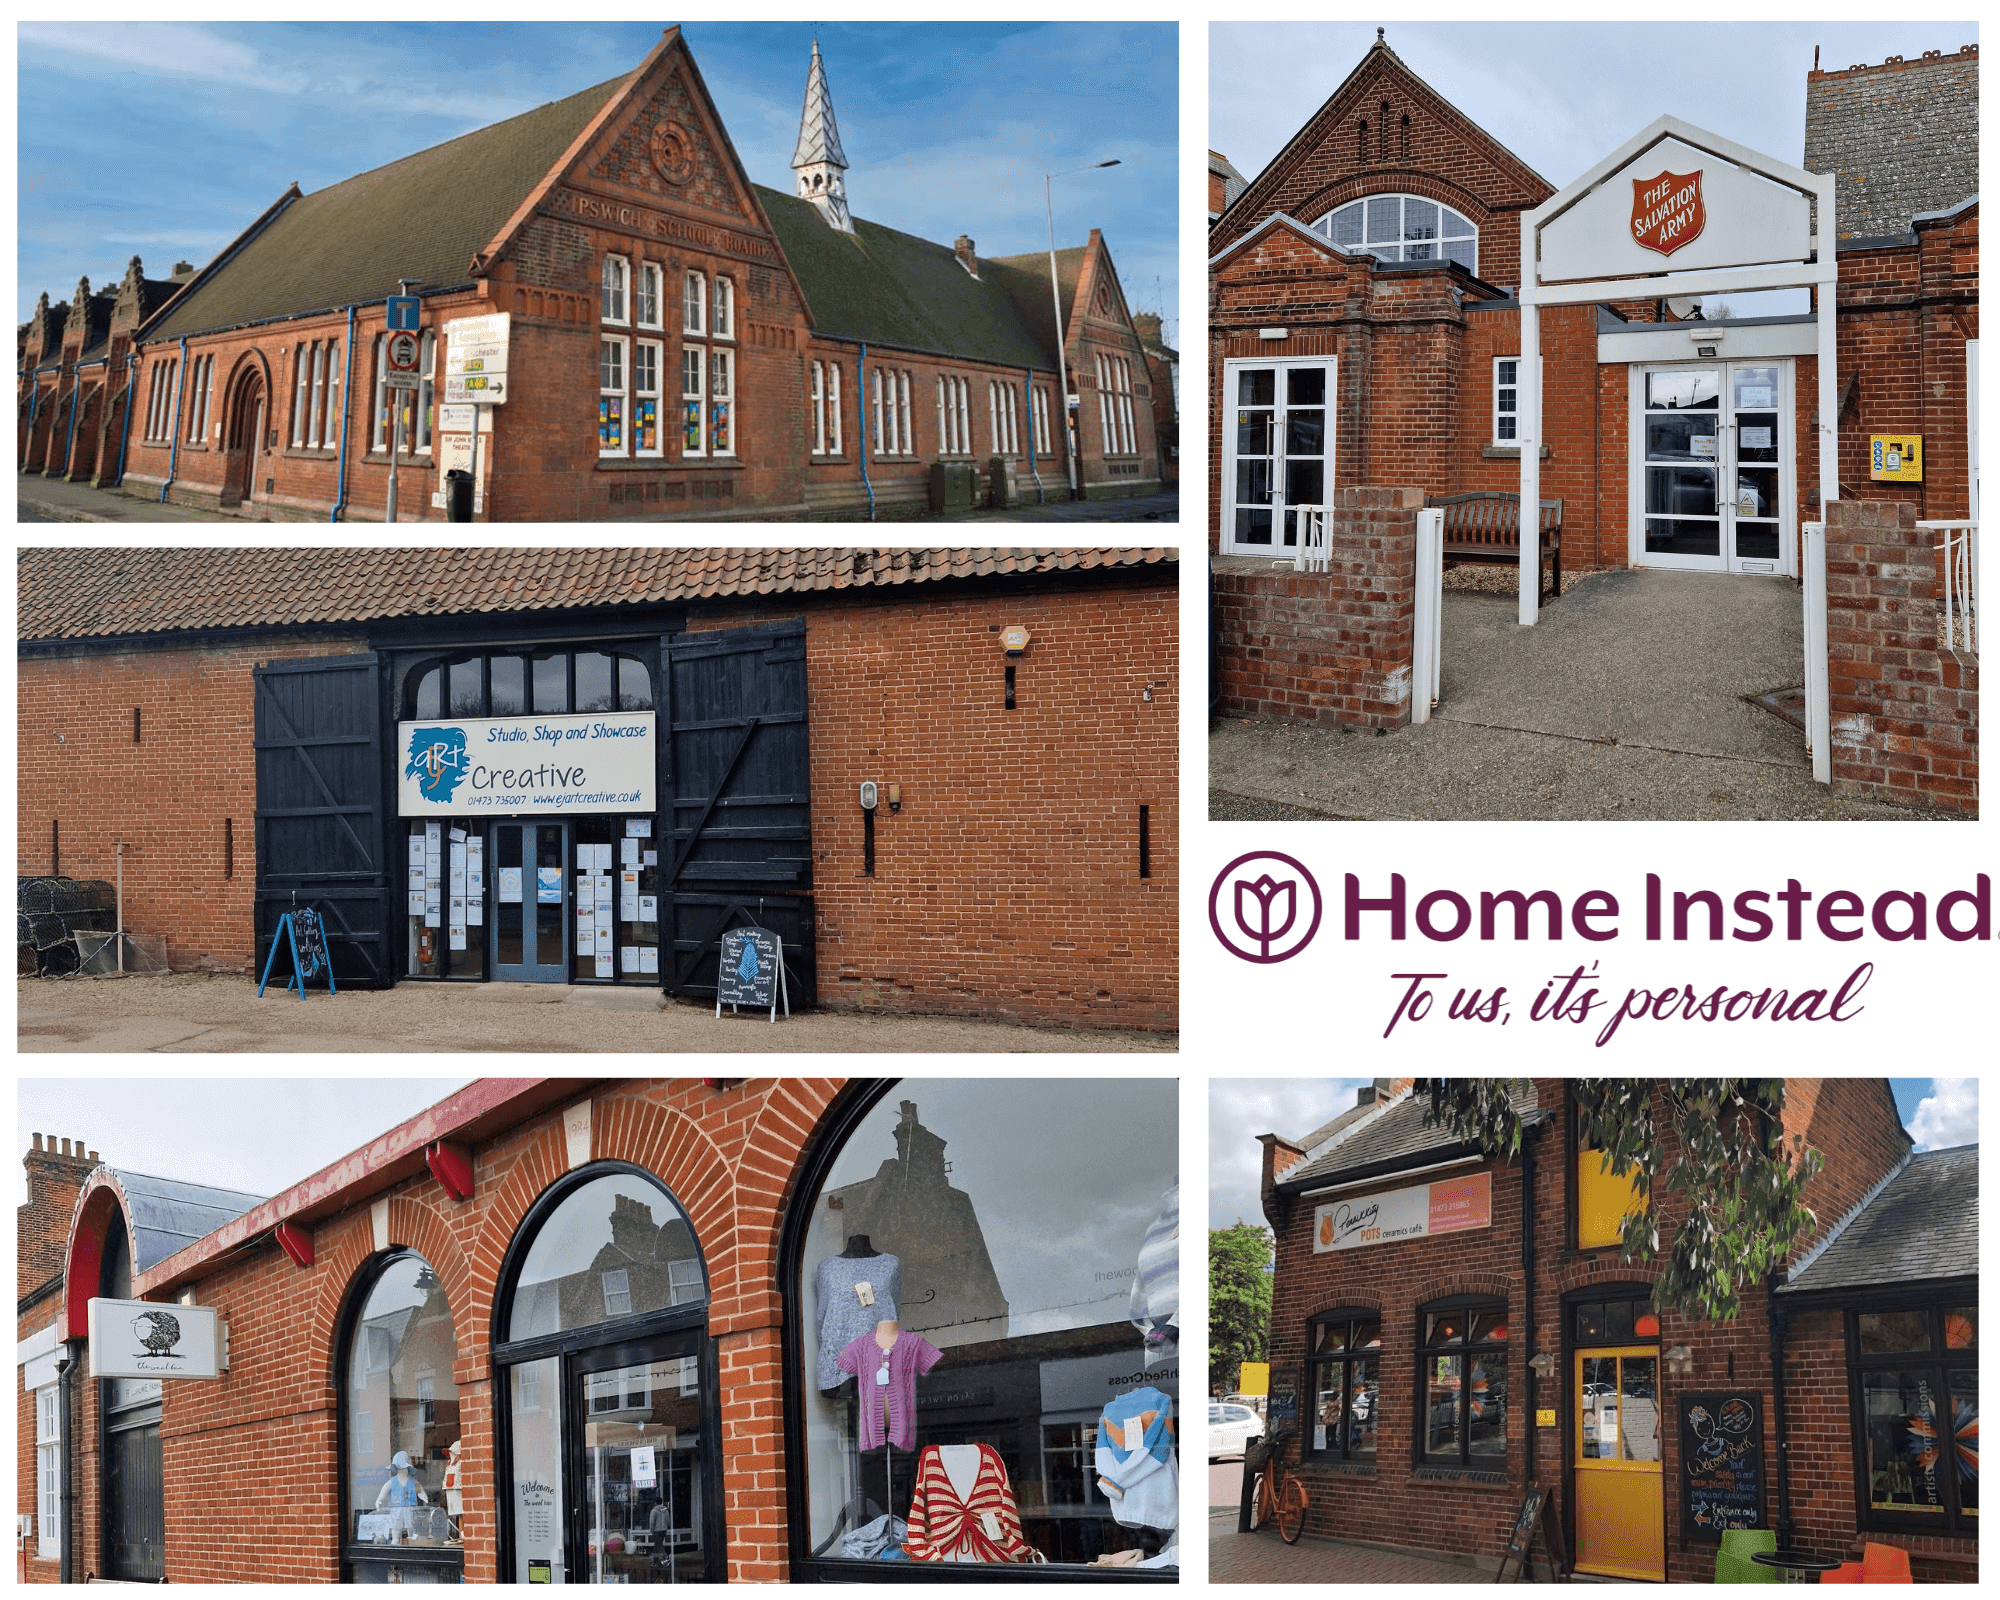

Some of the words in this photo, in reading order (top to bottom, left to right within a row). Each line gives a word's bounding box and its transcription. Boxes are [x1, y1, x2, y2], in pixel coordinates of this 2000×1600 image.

[1643, 179, 1671, 209] THE
[1634, 180, 1697, 237] SALVATION
[570, 196, 642, 228] IPSWICH
[724, 235, 766, 257] BOARD
[1659, 202, 1696, 245] ARMY
[487, 727, 529, 743] Studio,
[533, 724, 563, 747] Shop
[566, 723, 590, 740] and
[591, 722, 648, 740] Showcase
[472, 763, 587, 790] Creative
[468, 795, 492, 806] 01473
[495, 795, 527, 805] 735007
[1360, 1227, 1381, 1242] POTS
[1382, 1226, 1408, 1239] ceramics
[1409, 1223, 1423, 1234] café
[1687, 1450, 1728, 1476] Welcome
[1727, 1435, 1755, 1459] Back
[521, 1479, 555, 1496] Welcome
[1712, 1502, 1742, 1517] Entrance
[1713, 1515, 1728, 1530] Exit
